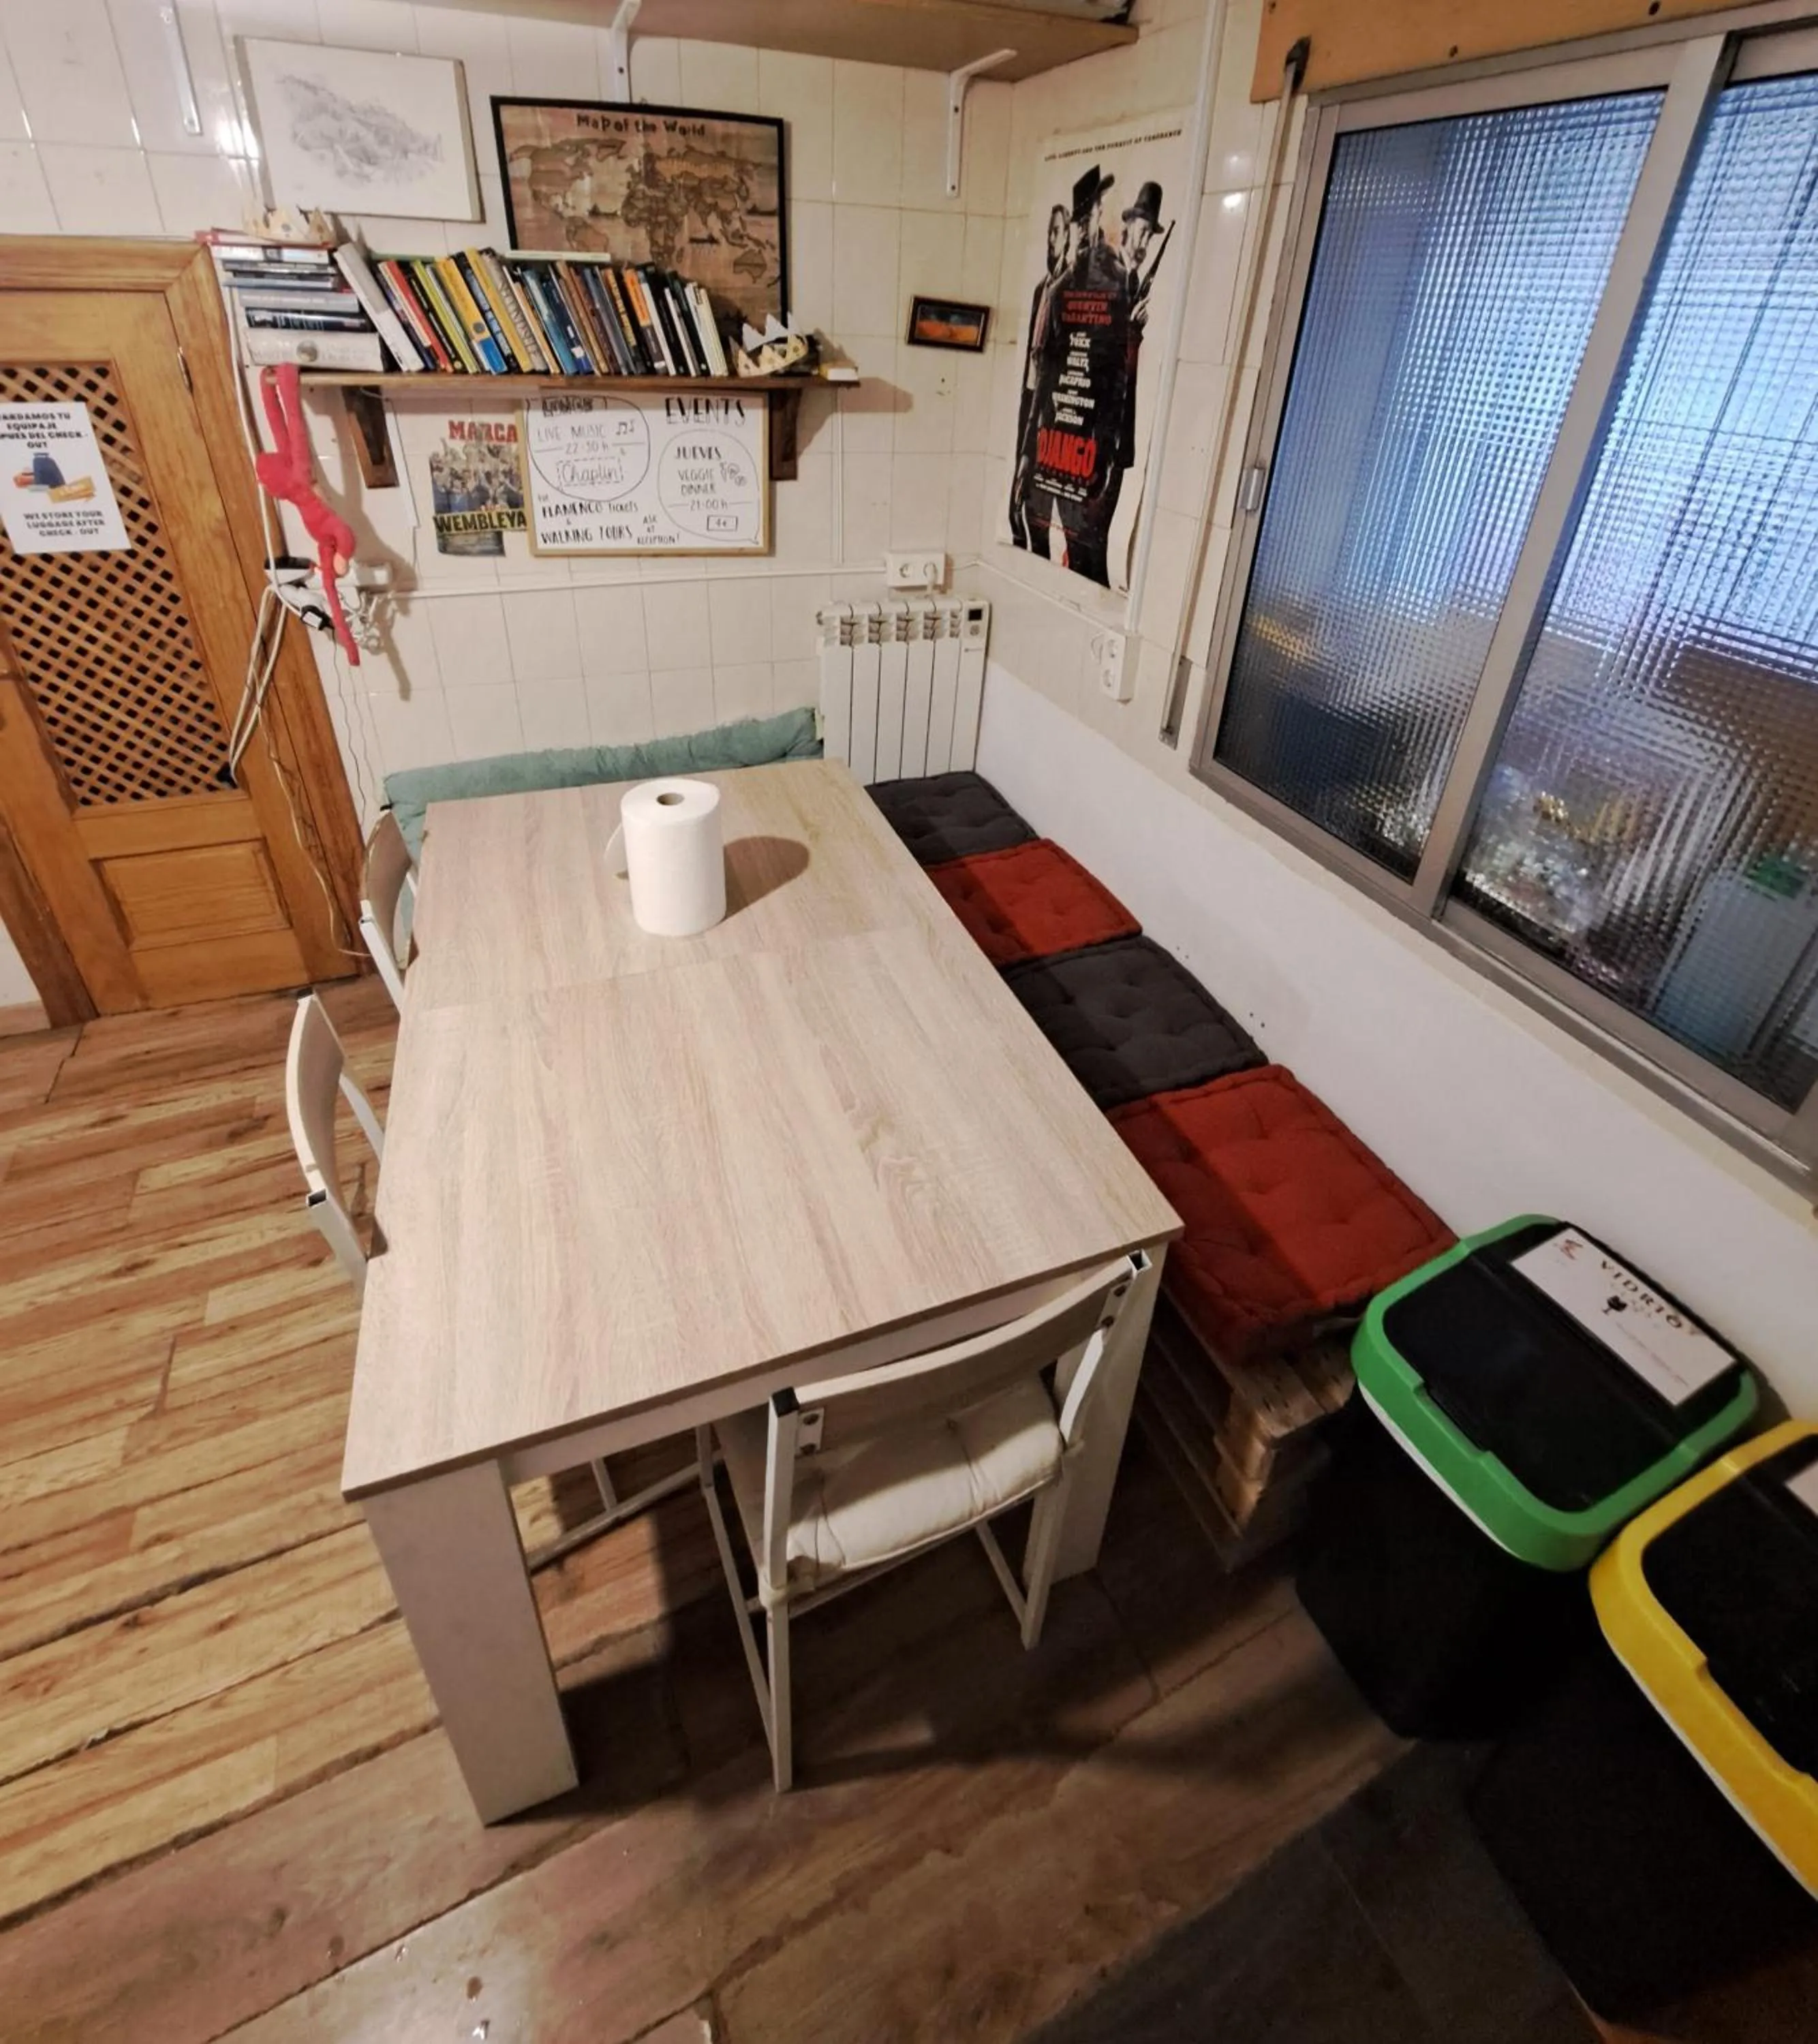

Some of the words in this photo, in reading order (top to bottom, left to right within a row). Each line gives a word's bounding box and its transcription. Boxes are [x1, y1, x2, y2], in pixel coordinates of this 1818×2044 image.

[577, 114, 613, 131] Map
[614, 119, 629, 131] of
[634, 119, 657, 133] the
[664, 121, 706, 136] World
[665, 397, 745, 427] EVENTS
[448, 420, 518, 443] MARCA
[538, 425, 561, 442] LIVE
[571, 424, 606, 438] MUSIC
[675, 446, 722, 460] JUEVES
[1037, 427, 1098, 480] DJANGO
[562, 463, 617, 485] Chaplin
[542, 501, 603, 518] FLAMENCO
[433, 510, 527, 534] WEMBLEYA
[541, 527, 593, 544] WALKING
[600, 525, 632, 540] TOURS
[1601, 1260, 1683, 1329] VIDRIO
